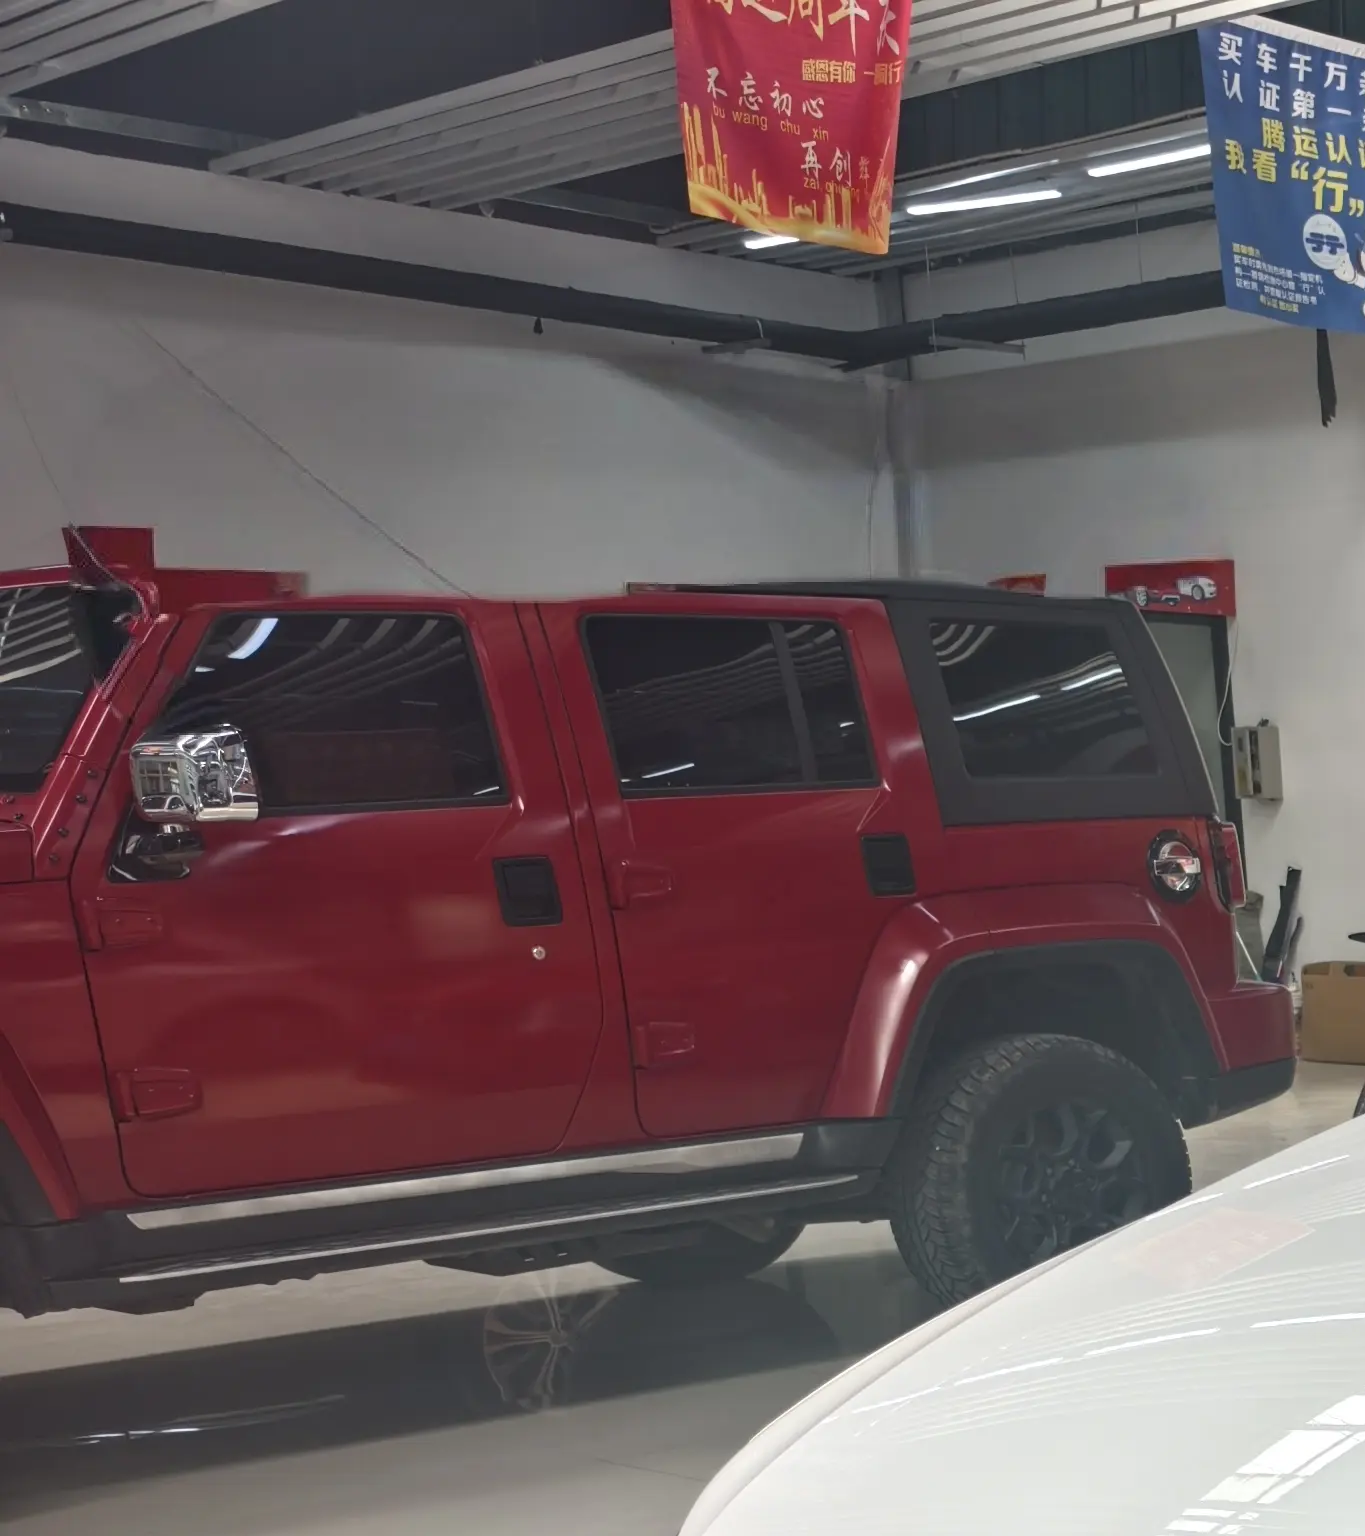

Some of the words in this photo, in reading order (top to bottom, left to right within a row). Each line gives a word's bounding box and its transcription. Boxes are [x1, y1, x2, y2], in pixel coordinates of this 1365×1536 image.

[706, 66, 824, 118] 不忘初心
[732, 109, 768, 131] wang
[780, 119, 800, 135] chu
